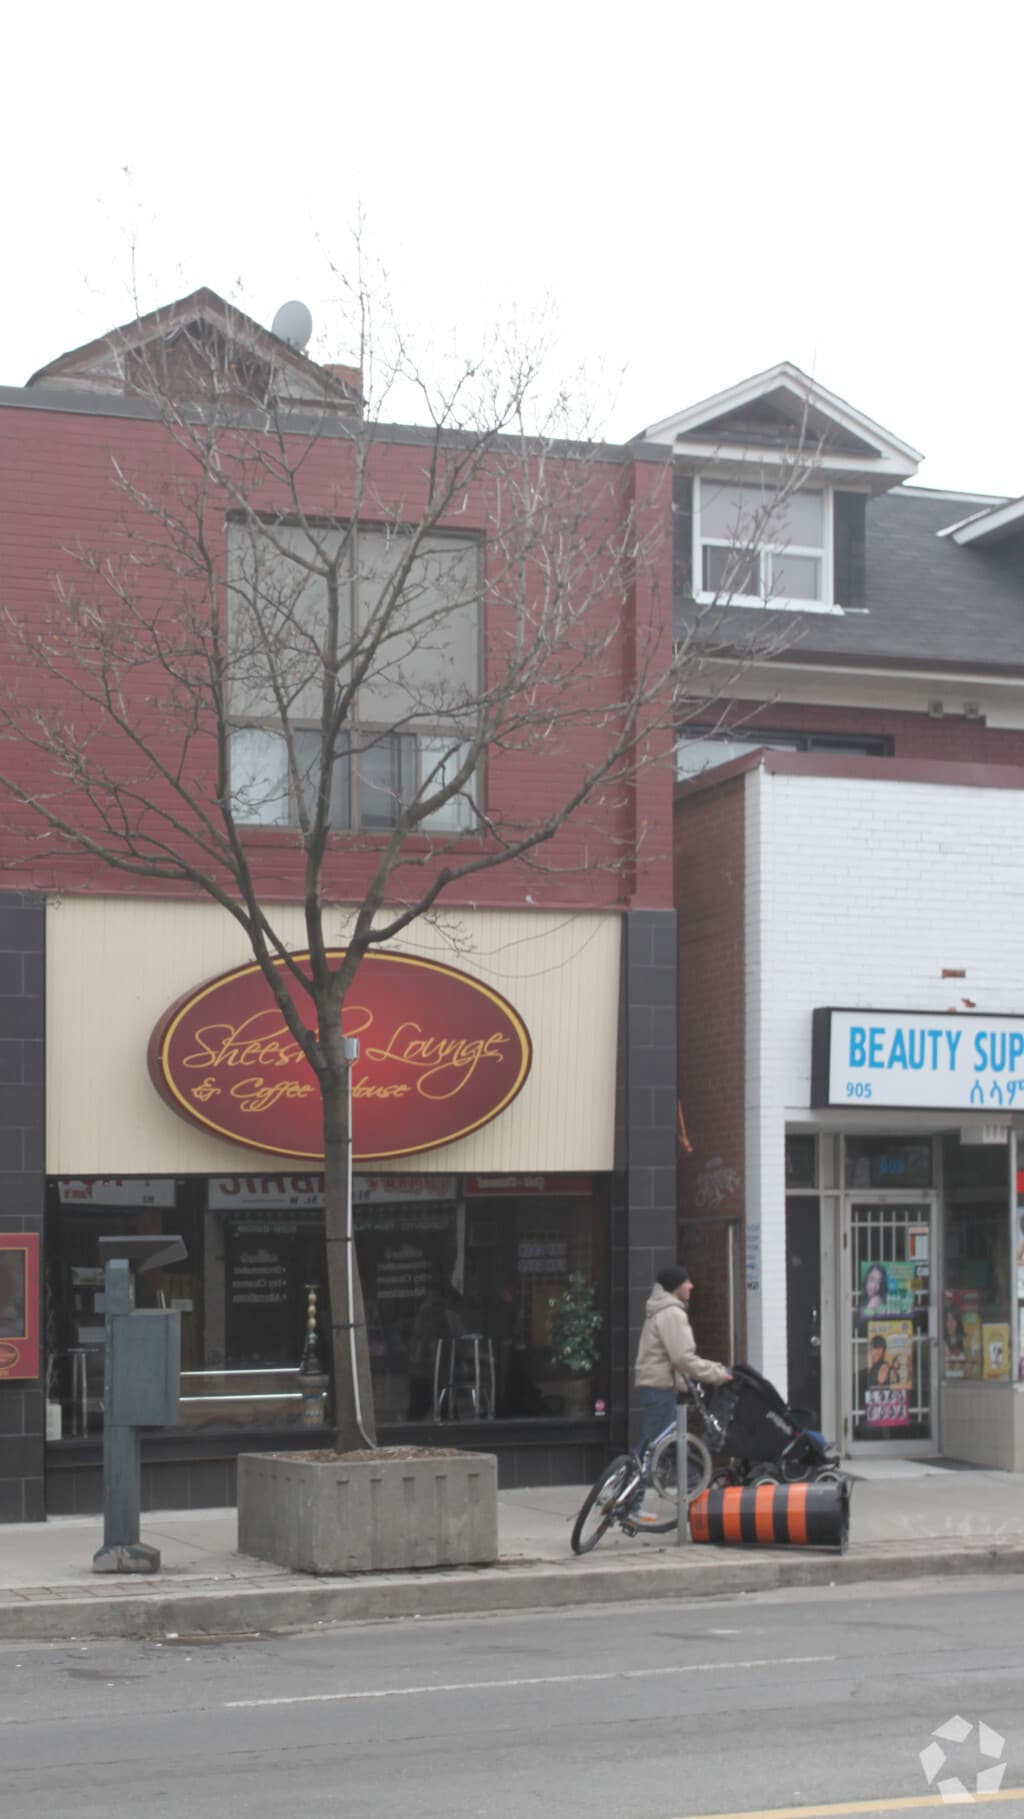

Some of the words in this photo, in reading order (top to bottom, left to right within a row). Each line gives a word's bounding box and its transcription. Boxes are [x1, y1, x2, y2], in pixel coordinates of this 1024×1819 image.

[183, 1005, 373, 1067] Shees
[366, 1022, 510, 1100] Lounge
[849, 1026, 962, 1071] BEAUTY
[974, 1031, 1024, 1073] SUP
[192, 1077, 221, 1102] &
[230, 1076, 315, 1112] Coffee
[320, 1083, 409, 1101] ouse
[846, 1081, 872, 1098] 905
